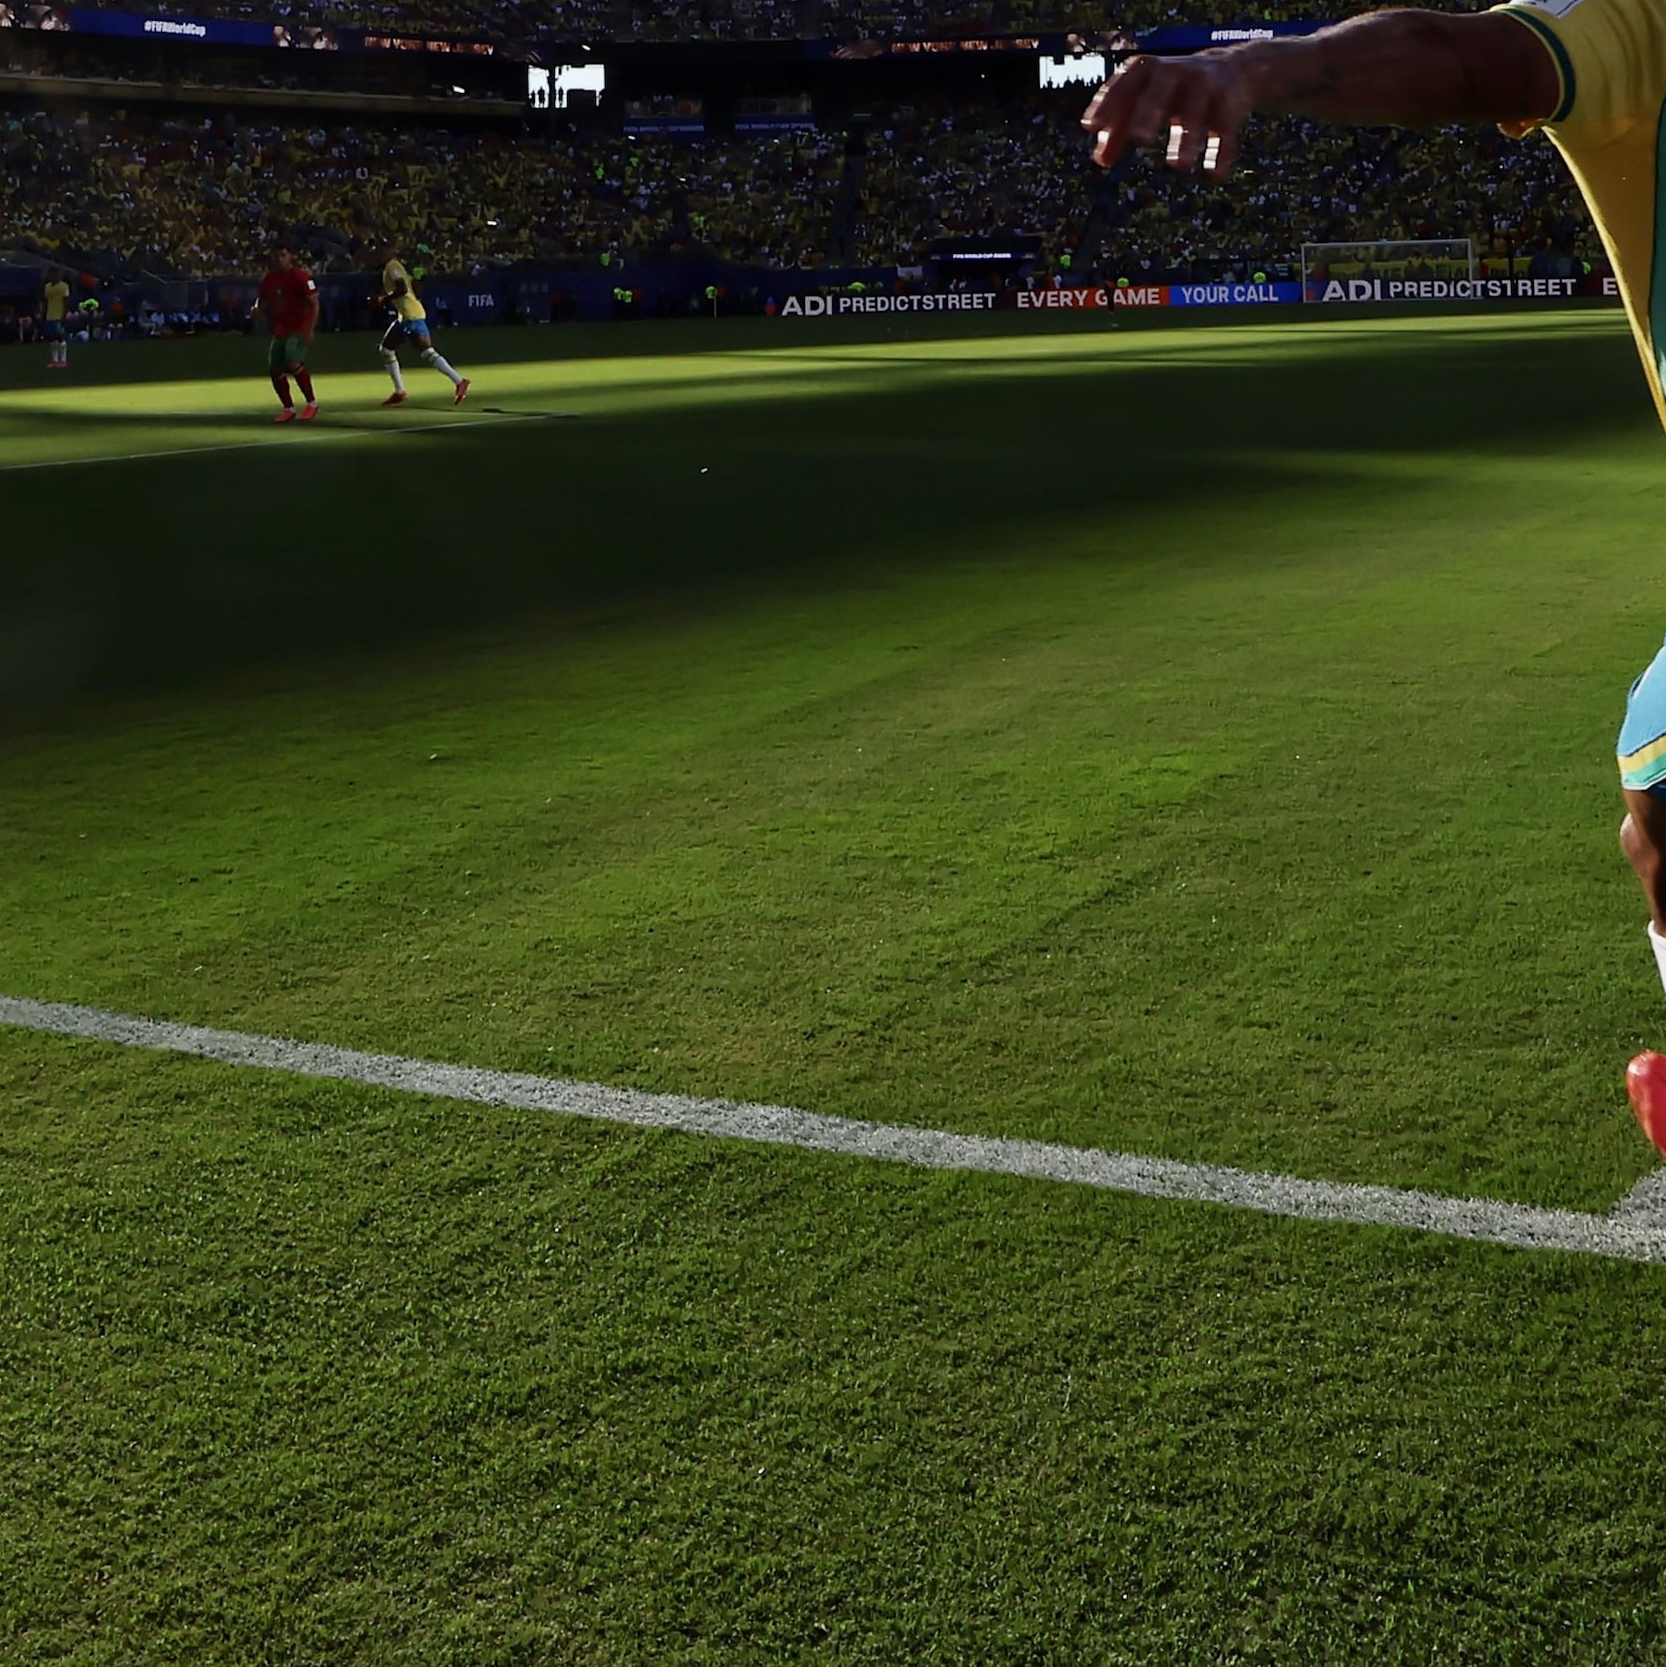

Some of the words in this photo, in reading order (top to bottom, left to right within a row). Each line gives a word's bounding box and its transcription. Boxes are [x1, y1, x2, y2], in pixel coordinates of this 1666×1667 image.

[144, 19, 206, 38] #FIFAWorldCup
[468, 295, 494, 308] FIFA
[1017, 290, 1088, 309] EVERY
[1094, 287, 1161, 307] GAME
[1181, 286, 1231, 304] YOUR
[1233, 284, 1280, 302] CALL
[1322, 279, 1383, 302] ADI
[1388, 278, 1577, 299] PREDICTSTREET
[781, 294, 833, 317] ADI
[839, 293, 997, 313] PREDICTSTREET
